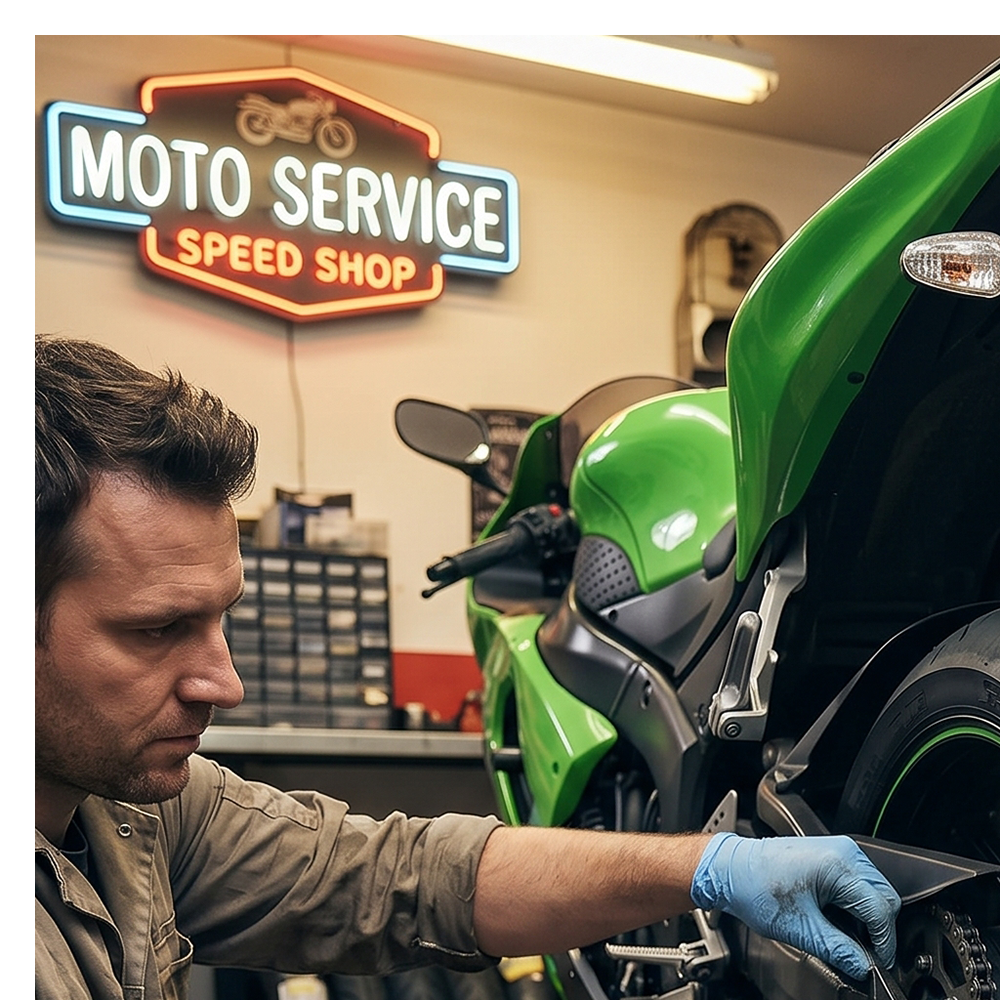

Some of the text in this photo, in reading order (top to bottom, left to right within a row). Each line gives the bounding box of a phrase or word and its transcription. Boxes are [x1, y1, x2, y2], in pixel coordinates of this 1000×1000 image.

[70, 125, 506, 254] MOTO SERVICE
[177, 228, 417, 291] SPEED SHOP
